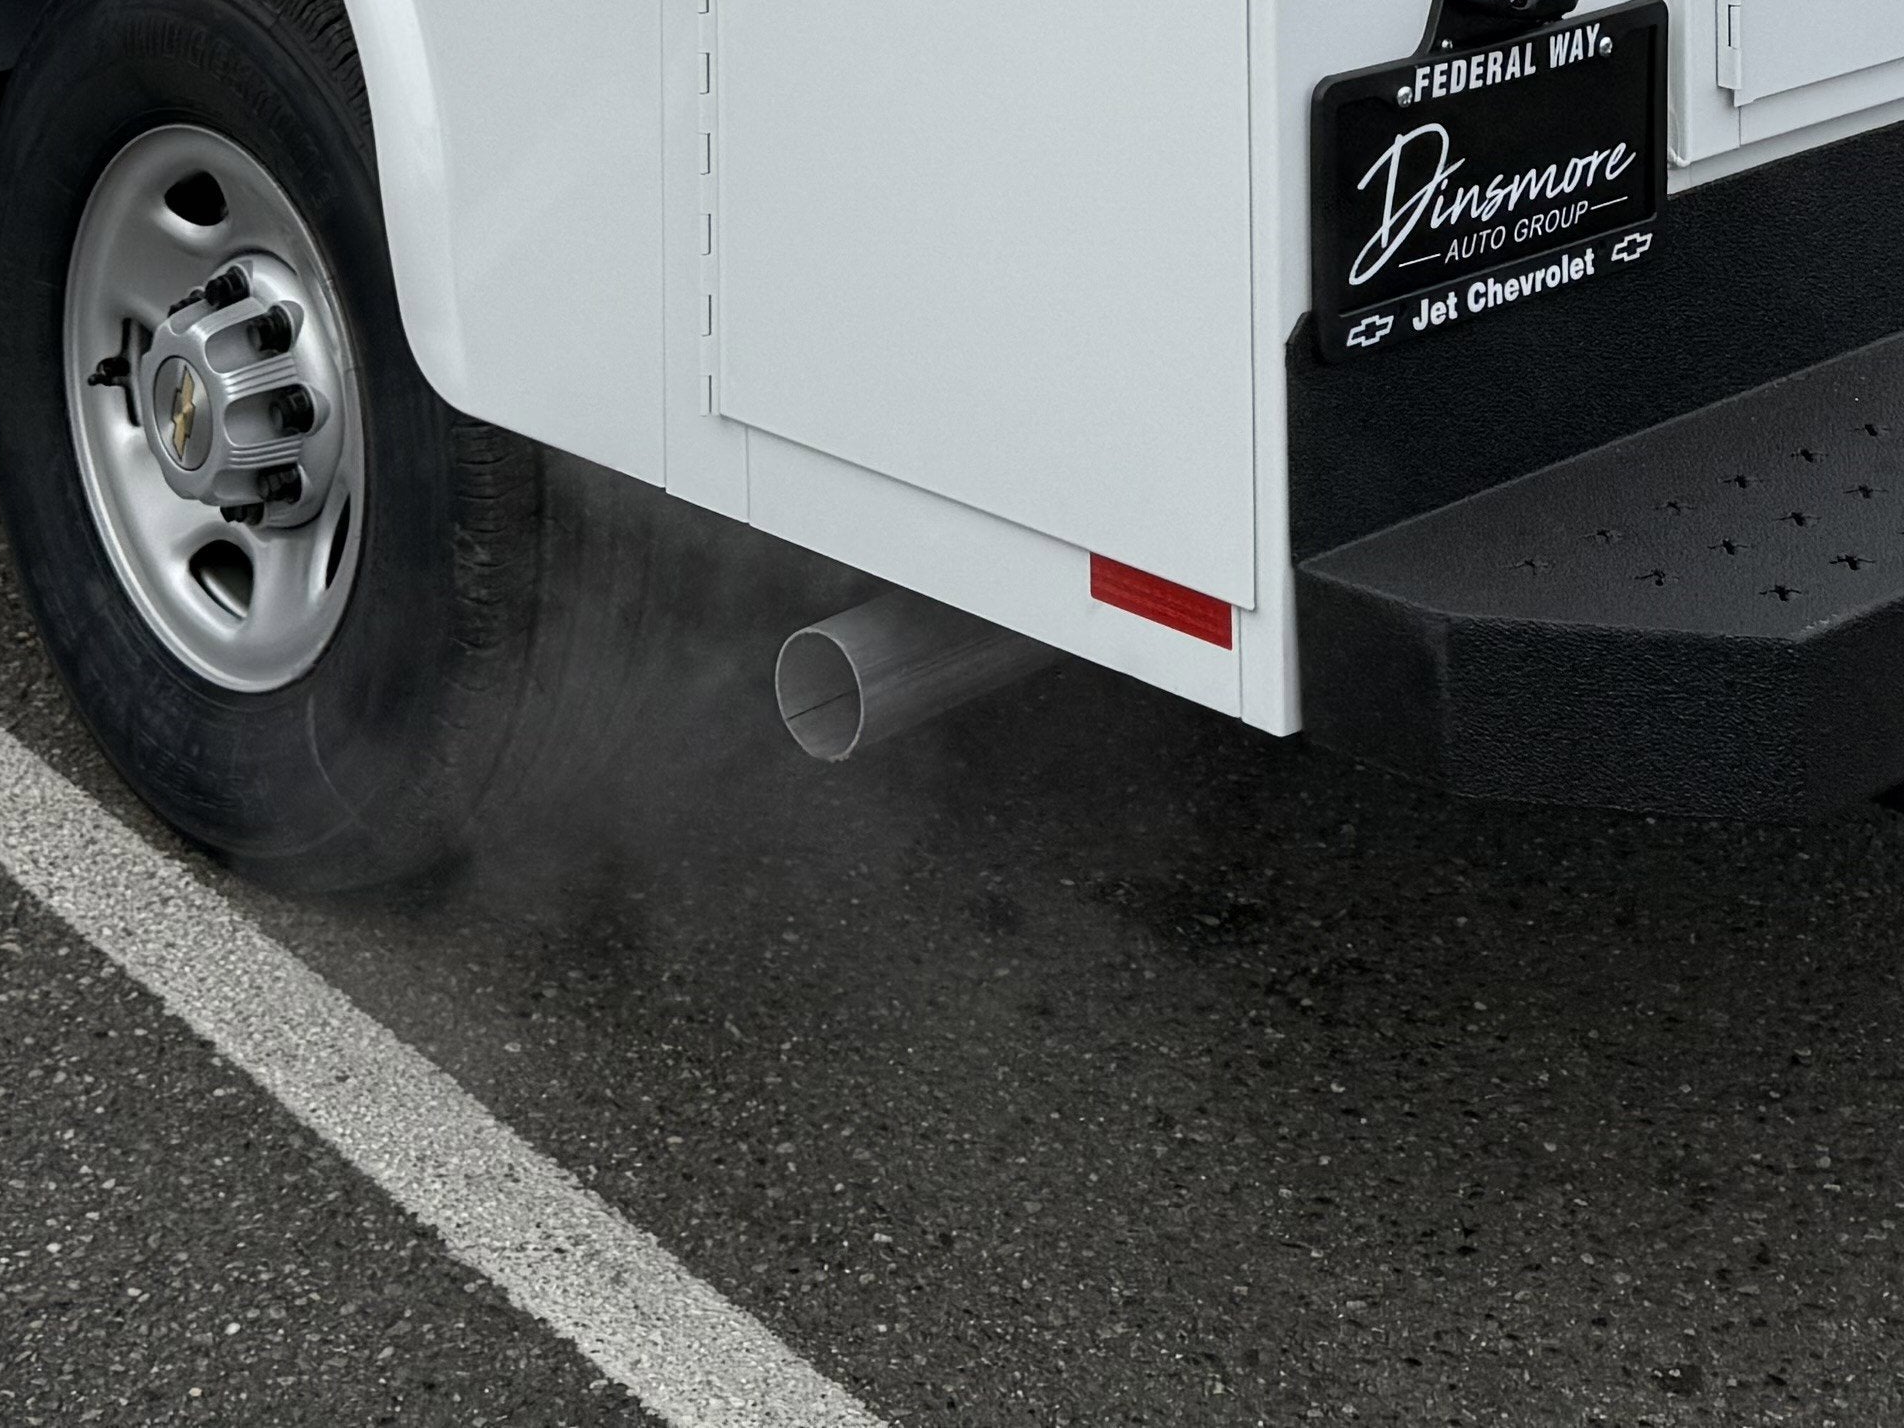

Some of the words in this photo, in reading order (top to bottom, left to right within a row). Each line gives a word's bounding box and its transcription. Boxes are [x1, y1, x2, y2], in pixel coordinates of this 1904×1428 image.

[1413, 42, 1537, 103] FEDERAL
[1549, 22, 1601, 69] WAY
[1348, 122, 1637, 285] Dinsmore
[1444, 225, 1507, 264] AUTO
[1513, 200, 1589, 243] GROUP
[1411, 291, 1458, 332] Jet
[1466, 247, 1595, 313] Chevrolet
